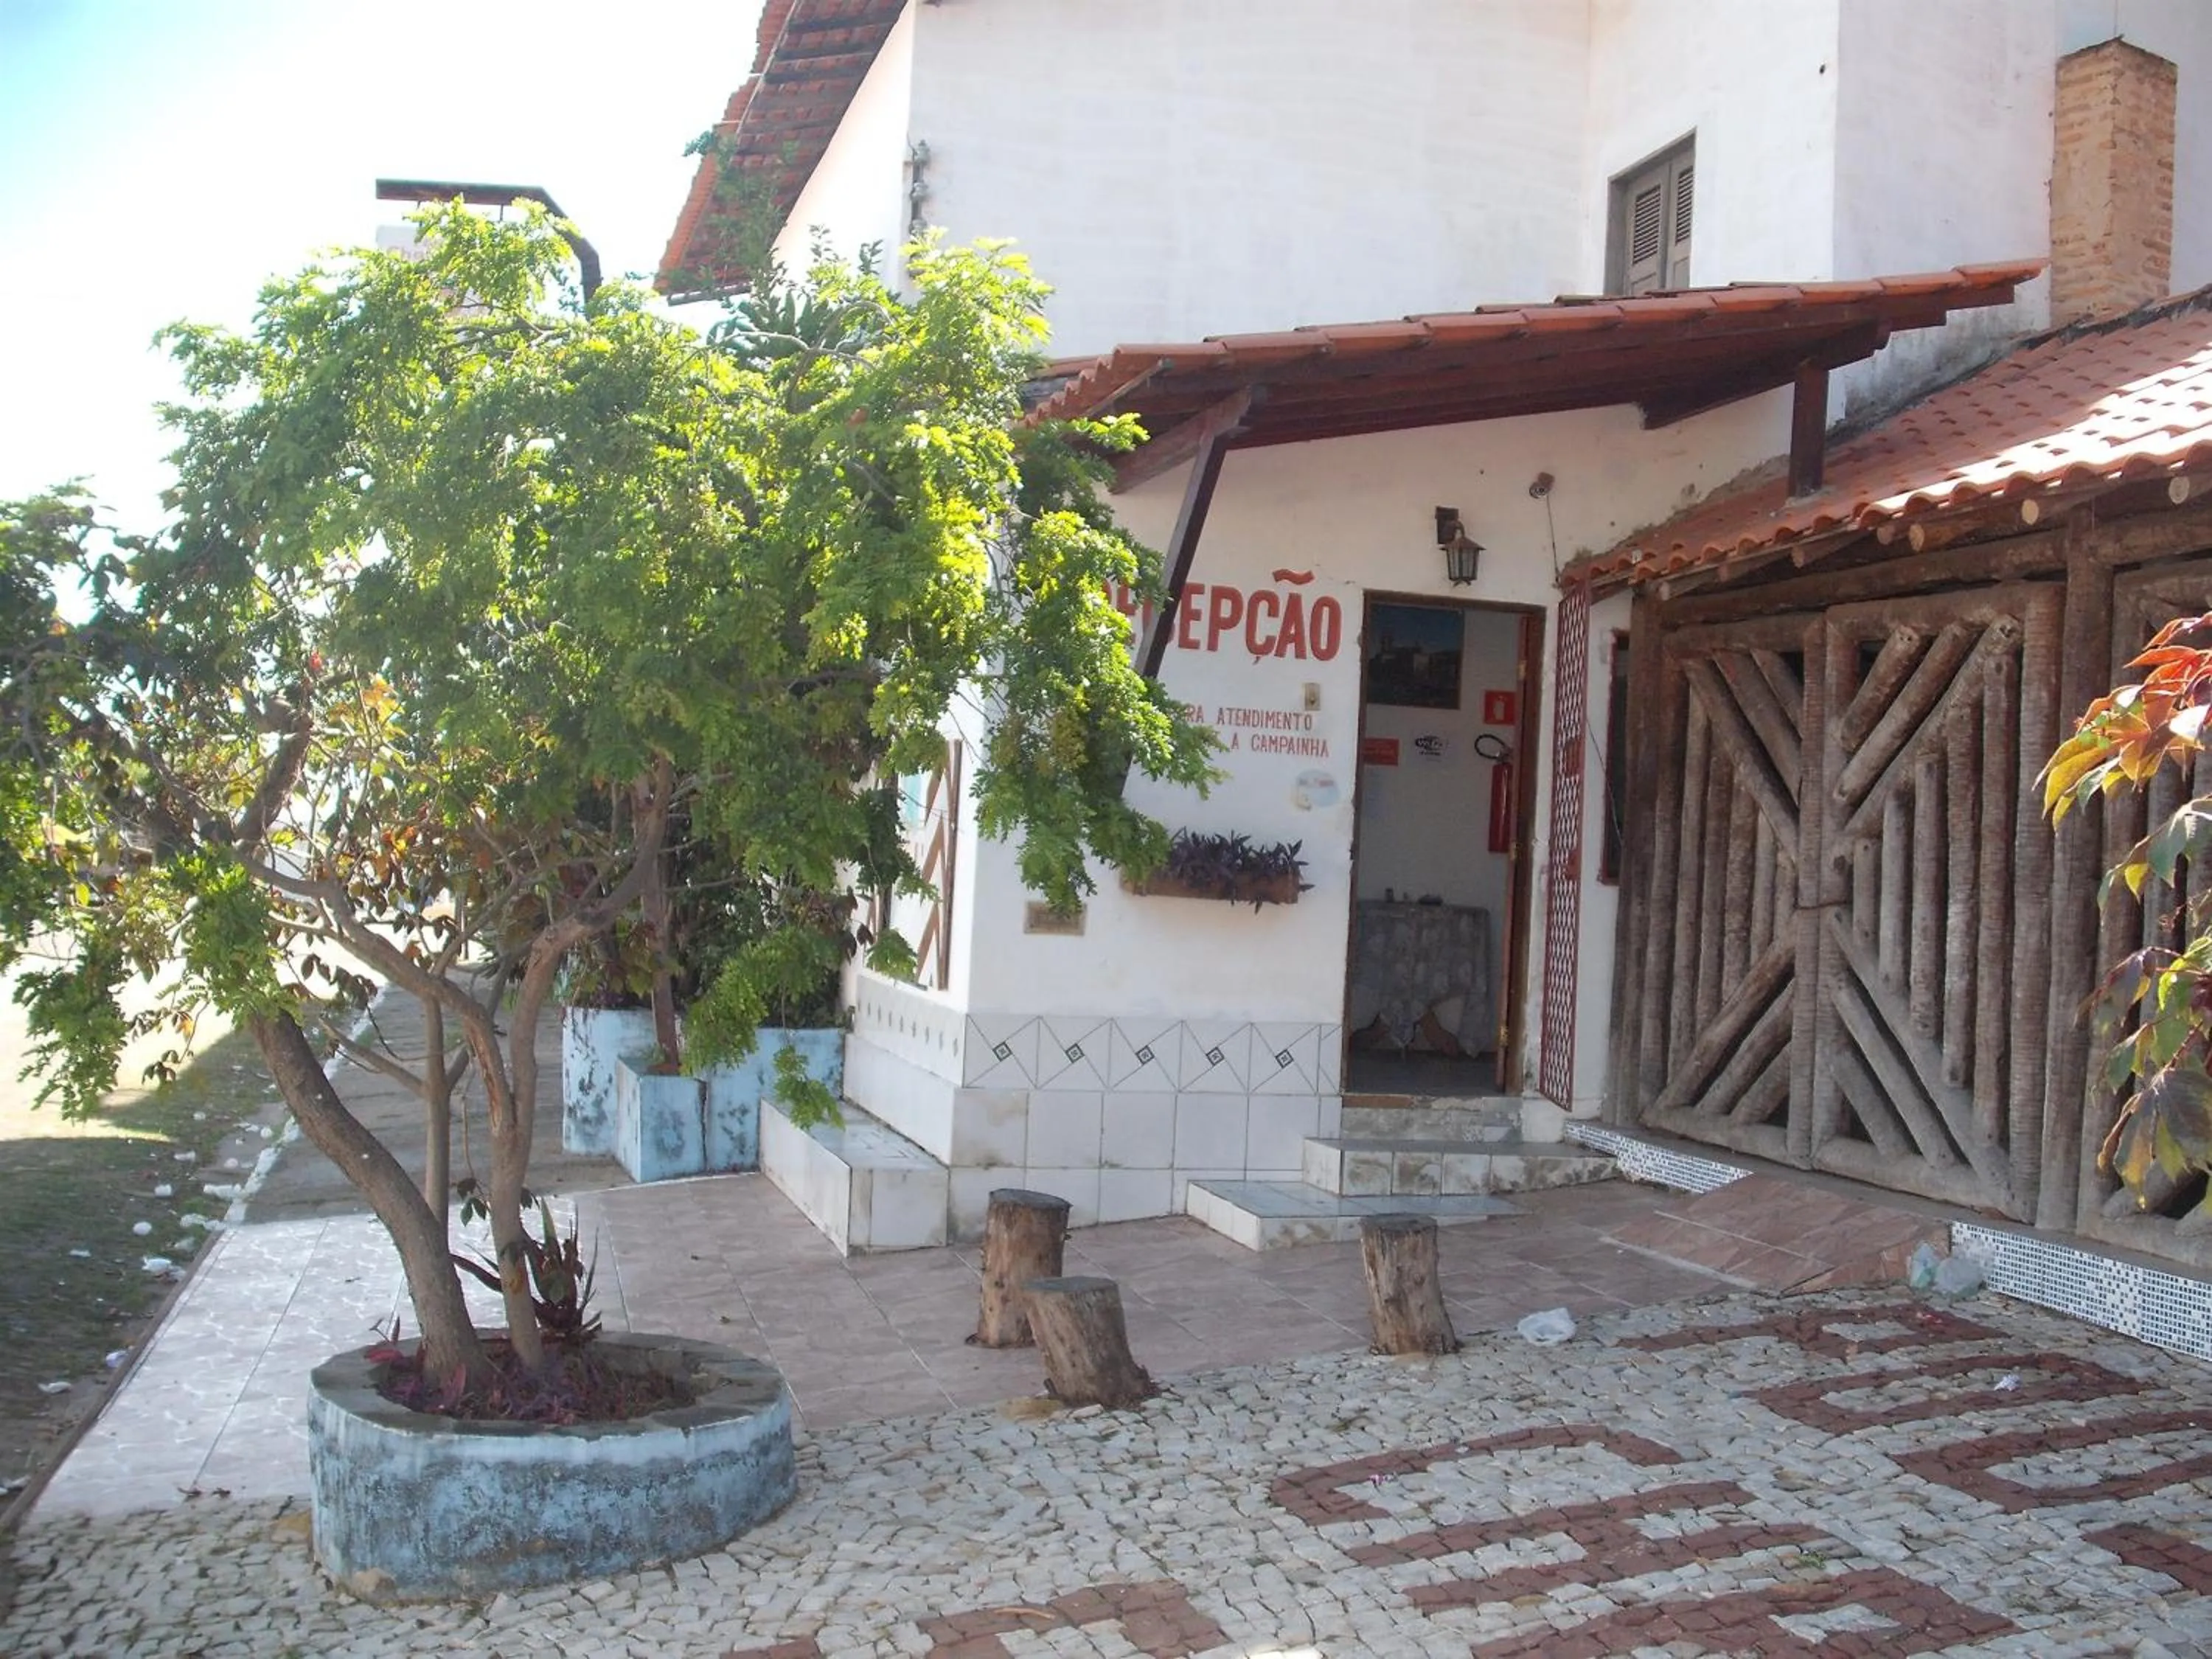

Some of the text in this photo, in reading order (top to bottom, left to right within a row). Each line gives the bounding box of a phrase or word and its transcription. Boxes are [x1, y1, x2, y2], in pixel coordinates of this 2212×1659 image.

[1186, 705, 1312, 731] RA ATENDIMENTO
[1251, 735, 1329, 758] CAMPAINHA
